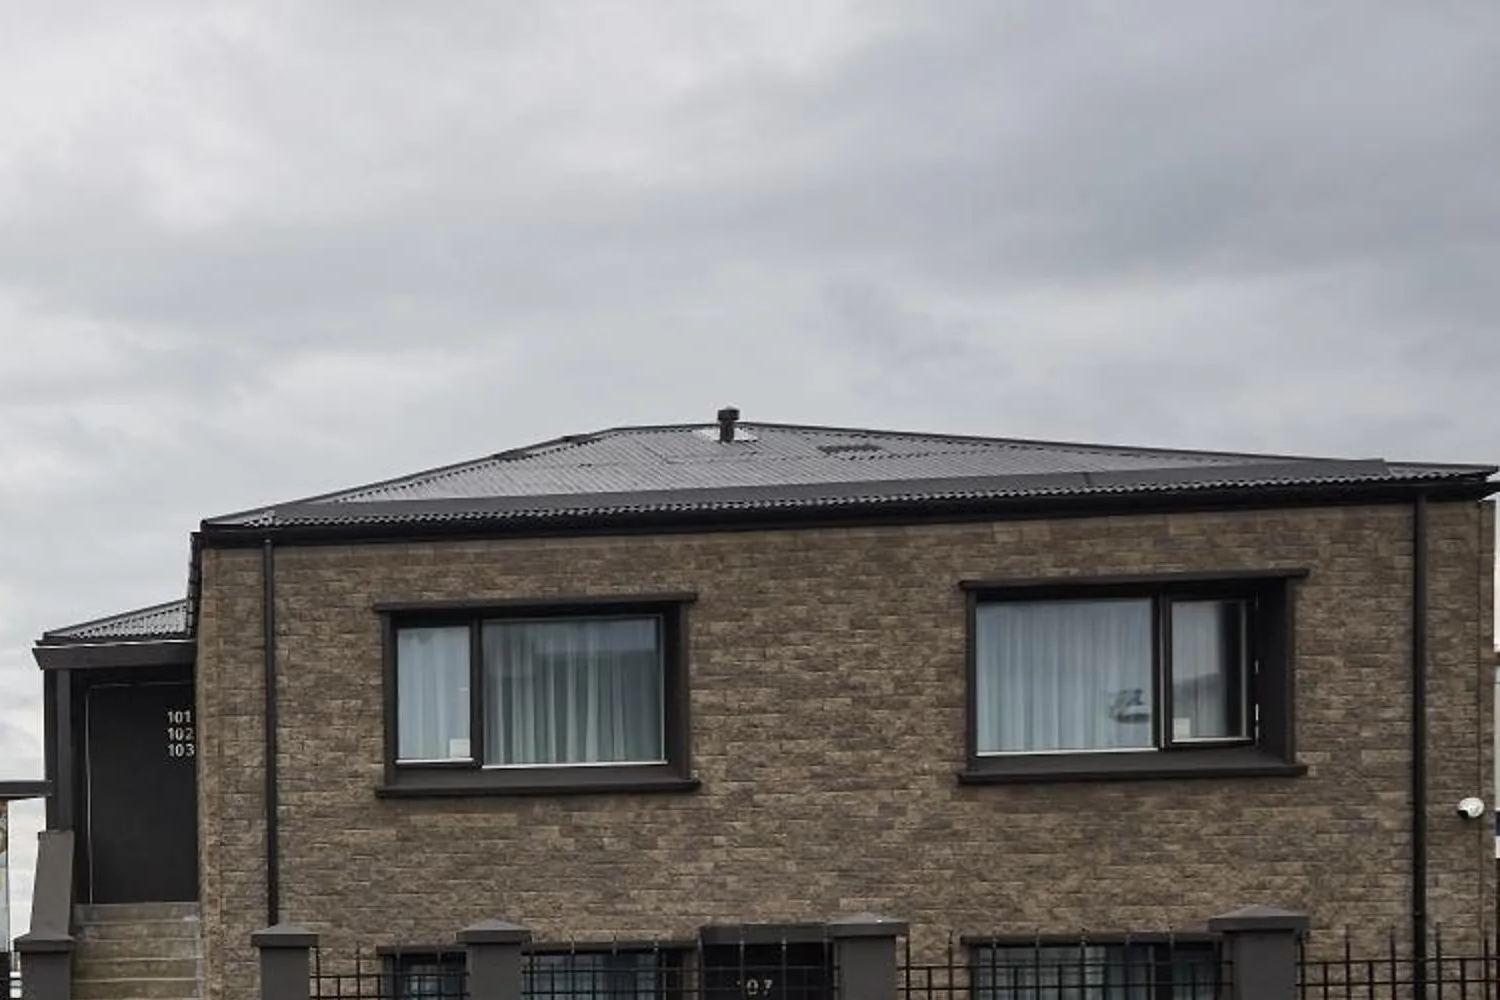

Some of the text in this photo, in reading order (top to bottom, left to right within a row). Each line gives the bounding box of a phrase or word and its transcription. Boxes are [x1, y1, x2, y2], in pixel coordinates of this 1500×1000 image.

[167, 710, 191, 724] 101
[167, 727, 194, 741] 102
[167, 743, 195, 757] 103
